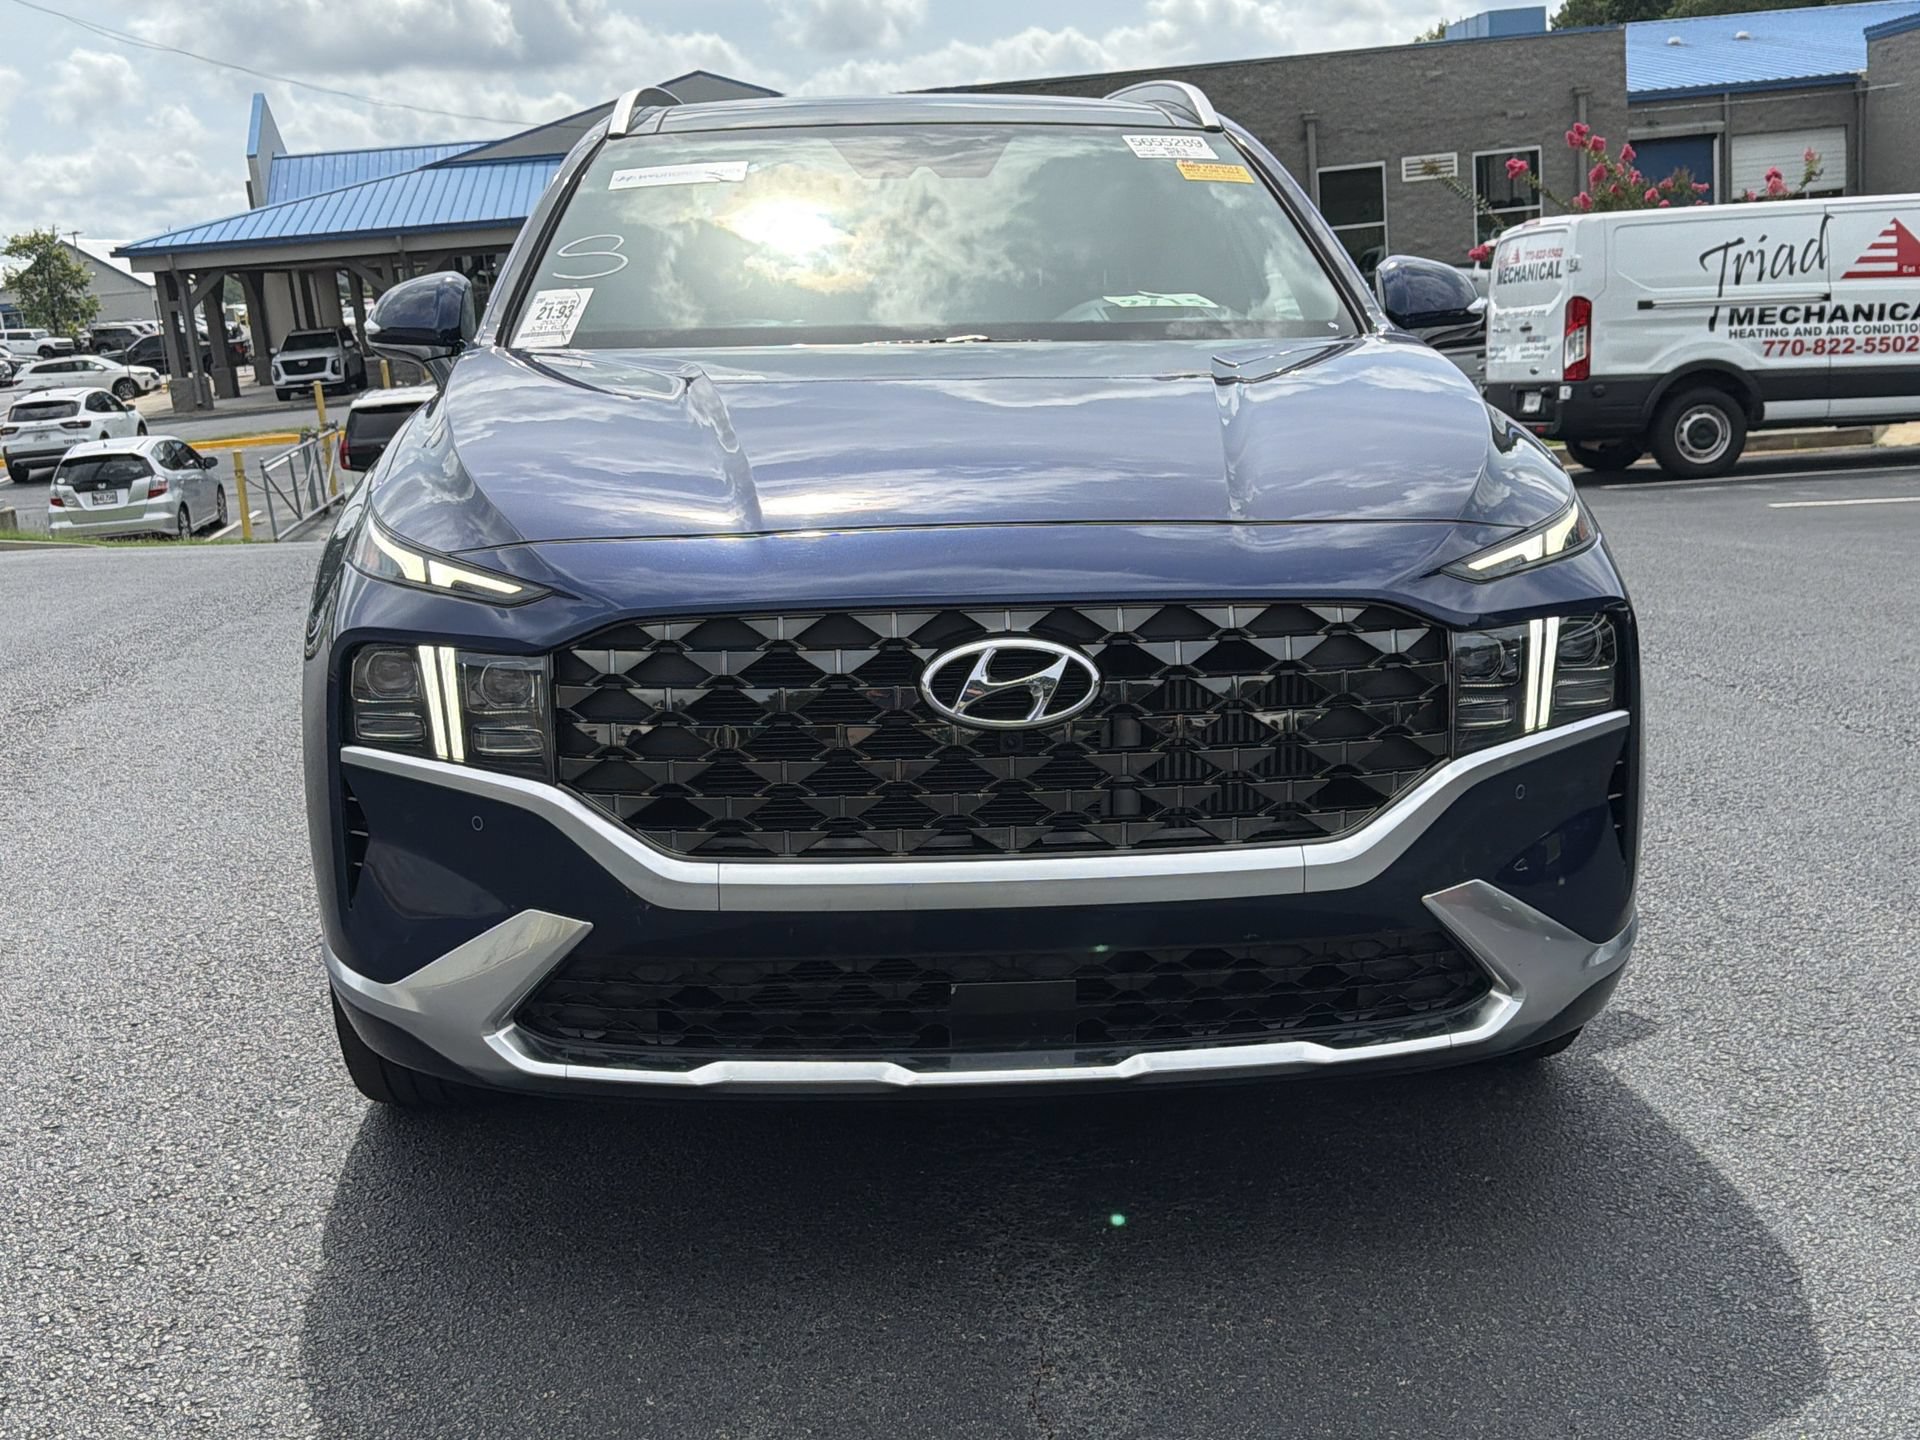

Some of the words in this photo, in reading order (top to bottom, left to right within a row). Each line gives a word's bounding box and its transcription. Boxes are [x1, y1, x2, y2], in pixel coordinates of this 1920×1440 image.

[1496, 260, 1563, 286] MECHANICAL
[1699, 214, 1834, 332] Triad
[1729, 326, 1790, 339] HEATING
[1793, 326, 1823, 337] AND
[1826, 325, 1850, 336] AIR
[1853, 323, 1920, 336] CONDITIO
[1762, 335, 1920, 358] 770-822-5502
